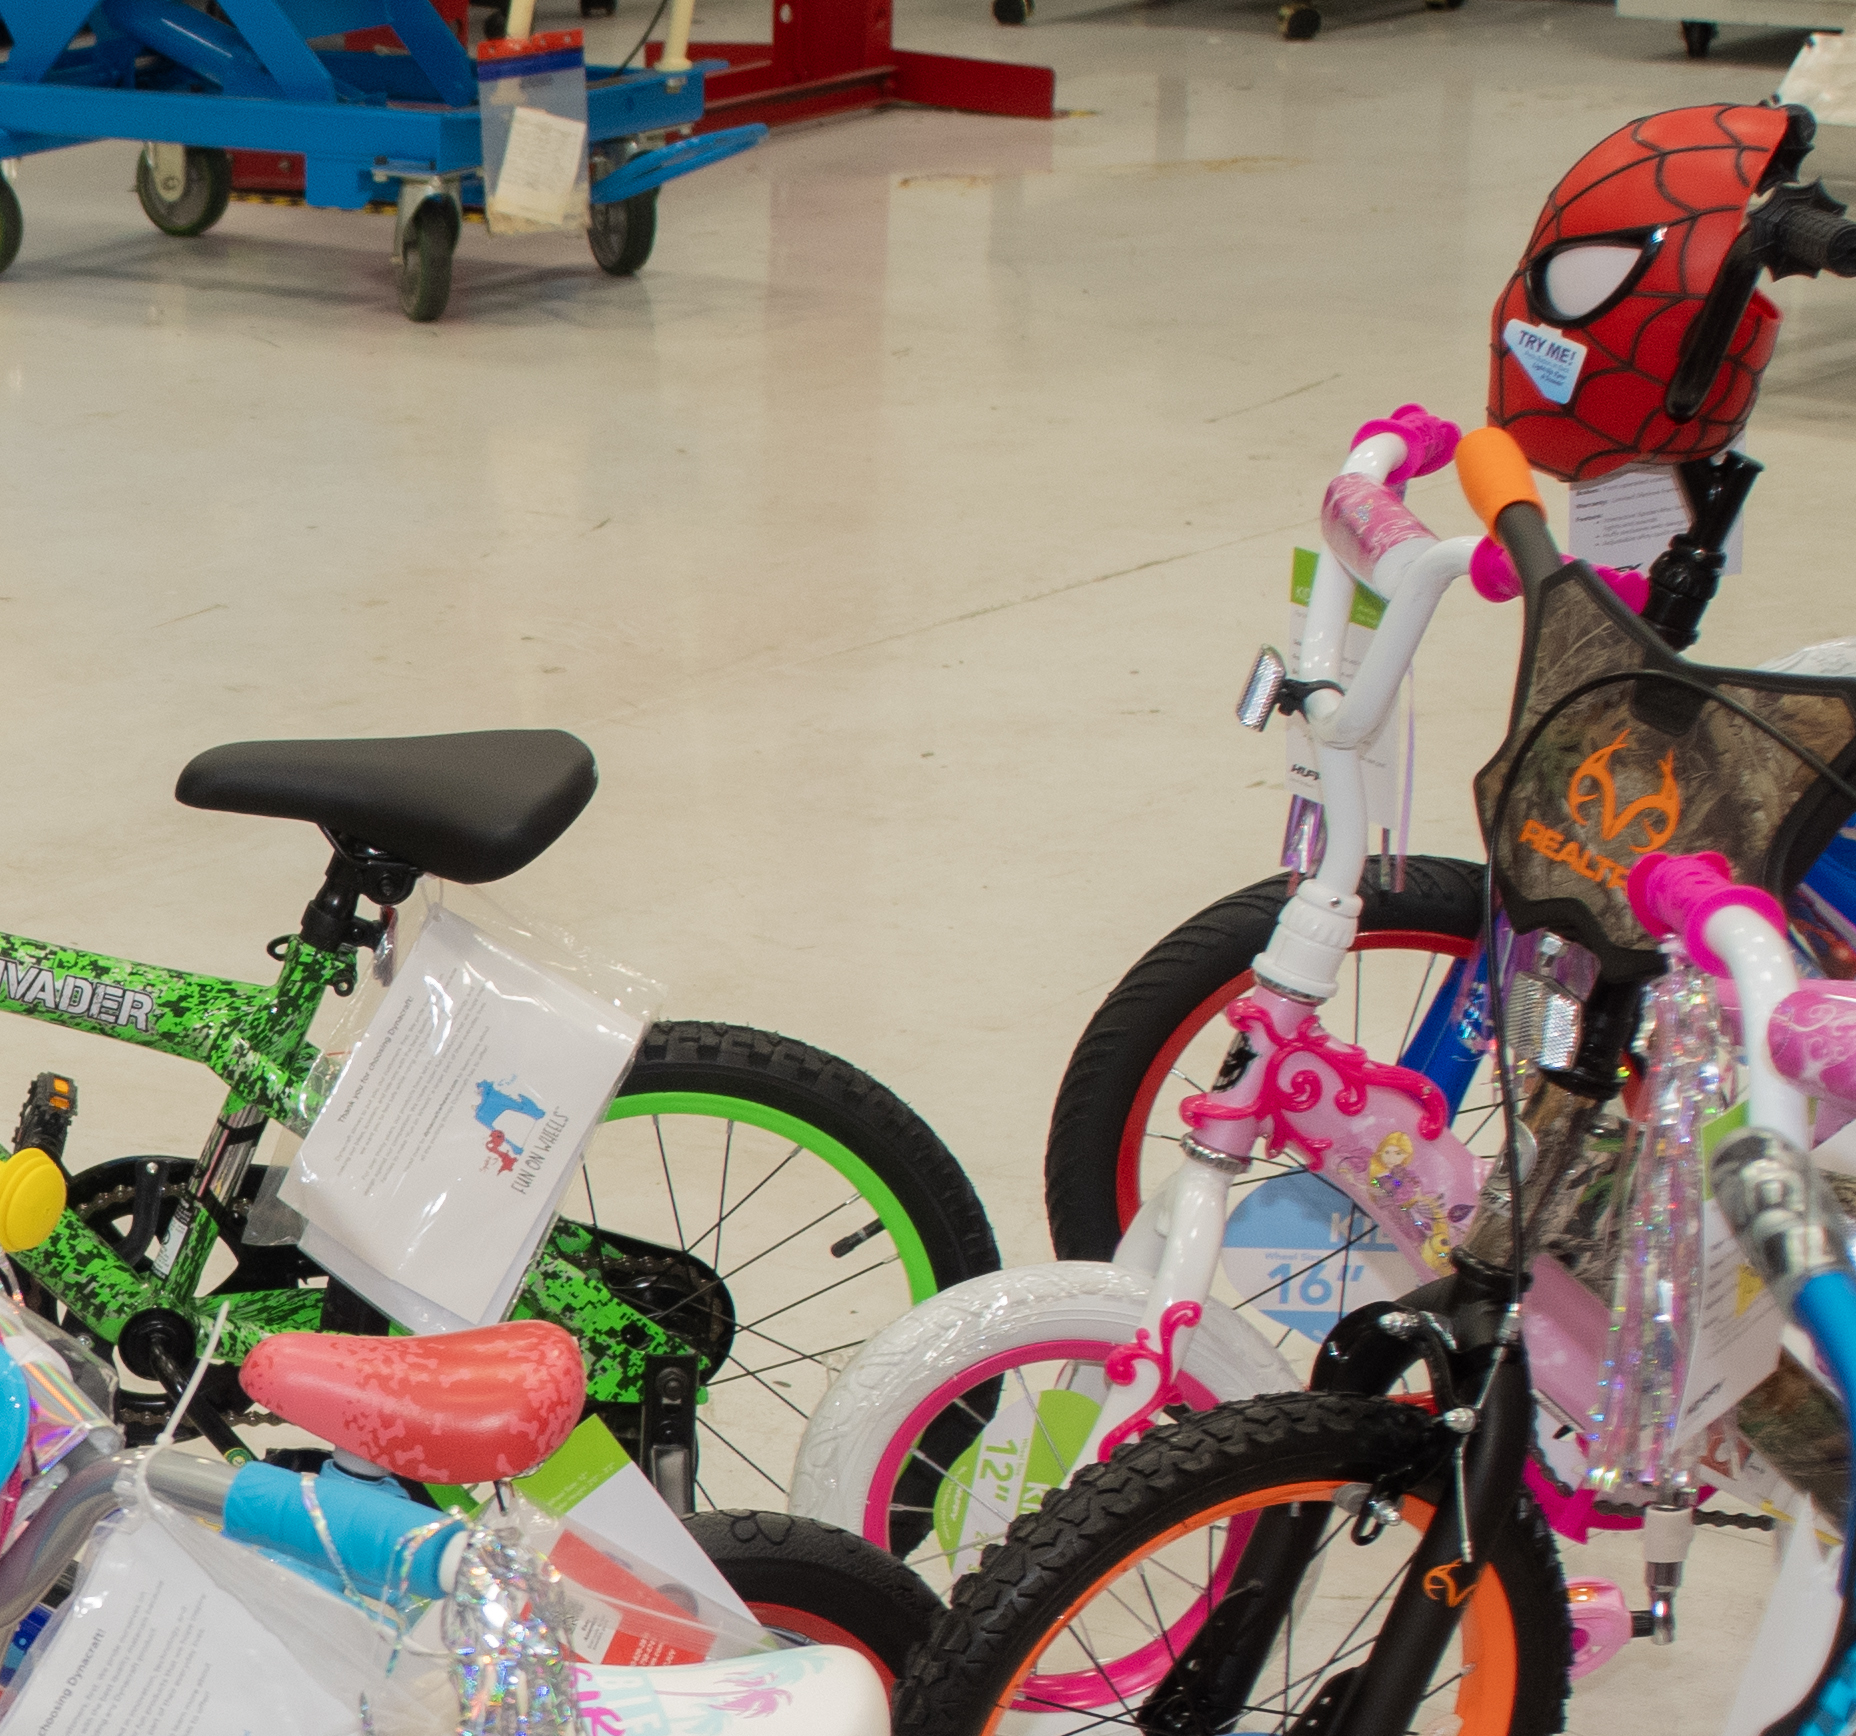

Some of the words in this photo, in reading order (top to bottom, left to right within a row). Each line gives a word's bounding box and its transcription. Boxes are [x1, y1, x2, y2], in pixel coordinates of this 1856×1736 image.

[1515, 329, 1549, 356] TRY
[1544, 340, 1577, 366] ME!
[337, 1098, 355, 1123] Thank
[352, 1083, 364, 1100] you
[358, 1070, 371, 1084] for
[367, 1034, 392, 1071] choosing
[386, 994, 415, 1036] Dynacraft!
[533, 1108, 570, 1155] WHEELS
[509, 1167, 536, 1195] FUN
[523, 1149, 546, 1172] ON
[1265, 1263, 1363, 1305] 16"
[975, 1437, 1023, 1503] 12"
[66, 1628, 107, 1687] Dynacraft!
